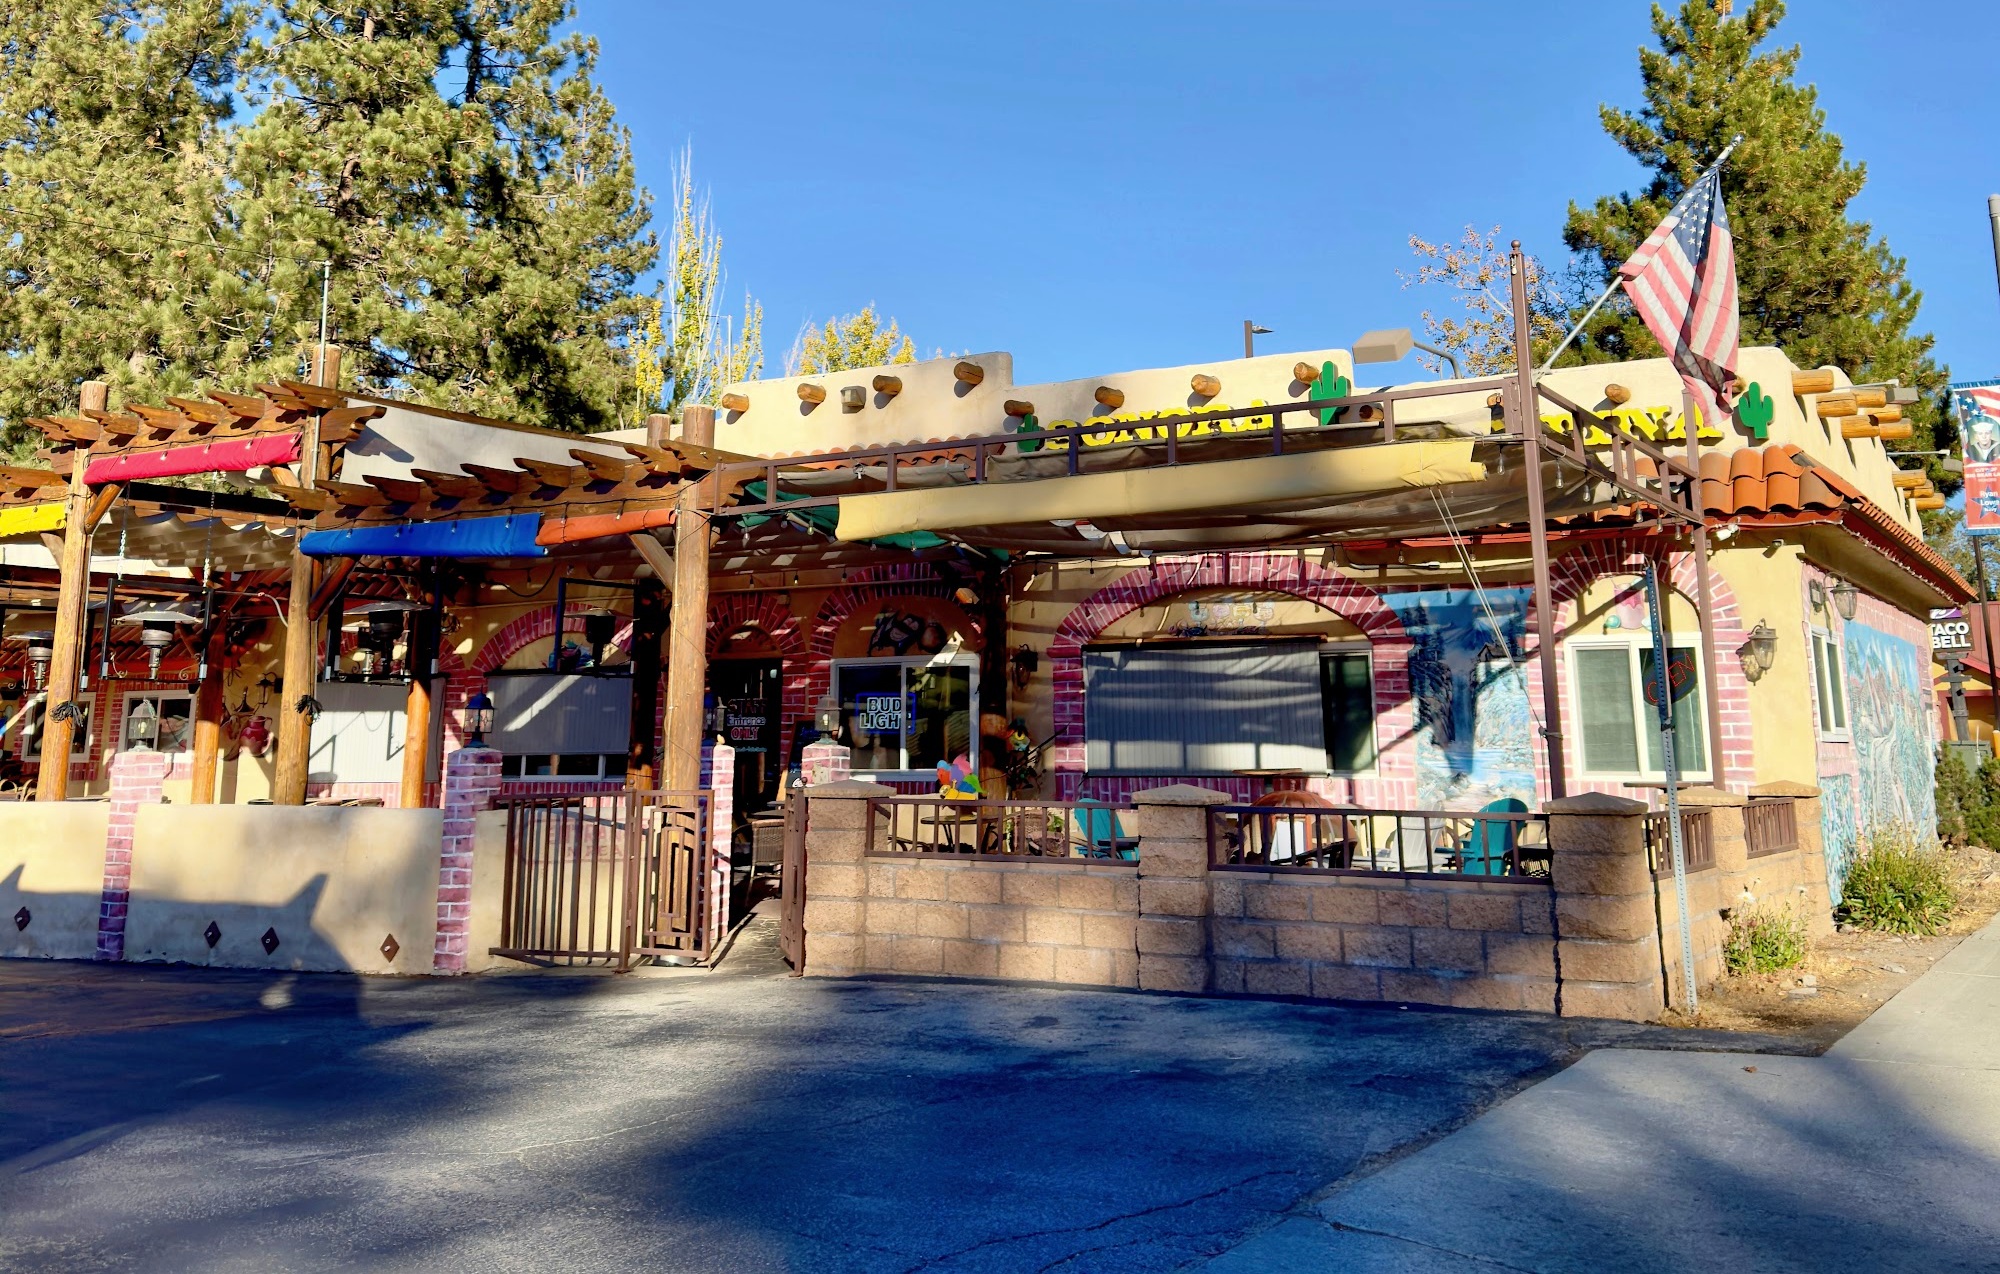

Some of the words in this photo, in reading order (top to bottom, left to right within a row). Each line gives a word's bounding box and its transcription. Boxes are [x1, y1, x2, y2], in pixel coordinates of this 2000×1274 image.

[1980, 490, 1999, 499] Ryan
[1930, 622, 1969, 636] TACO
[1932, 635, 1971, 649] BELL
[867, 697, 901, 713] BUD
[859, 713, 912, 729] LIGH
[731, 726, 760, 741] ONLY
